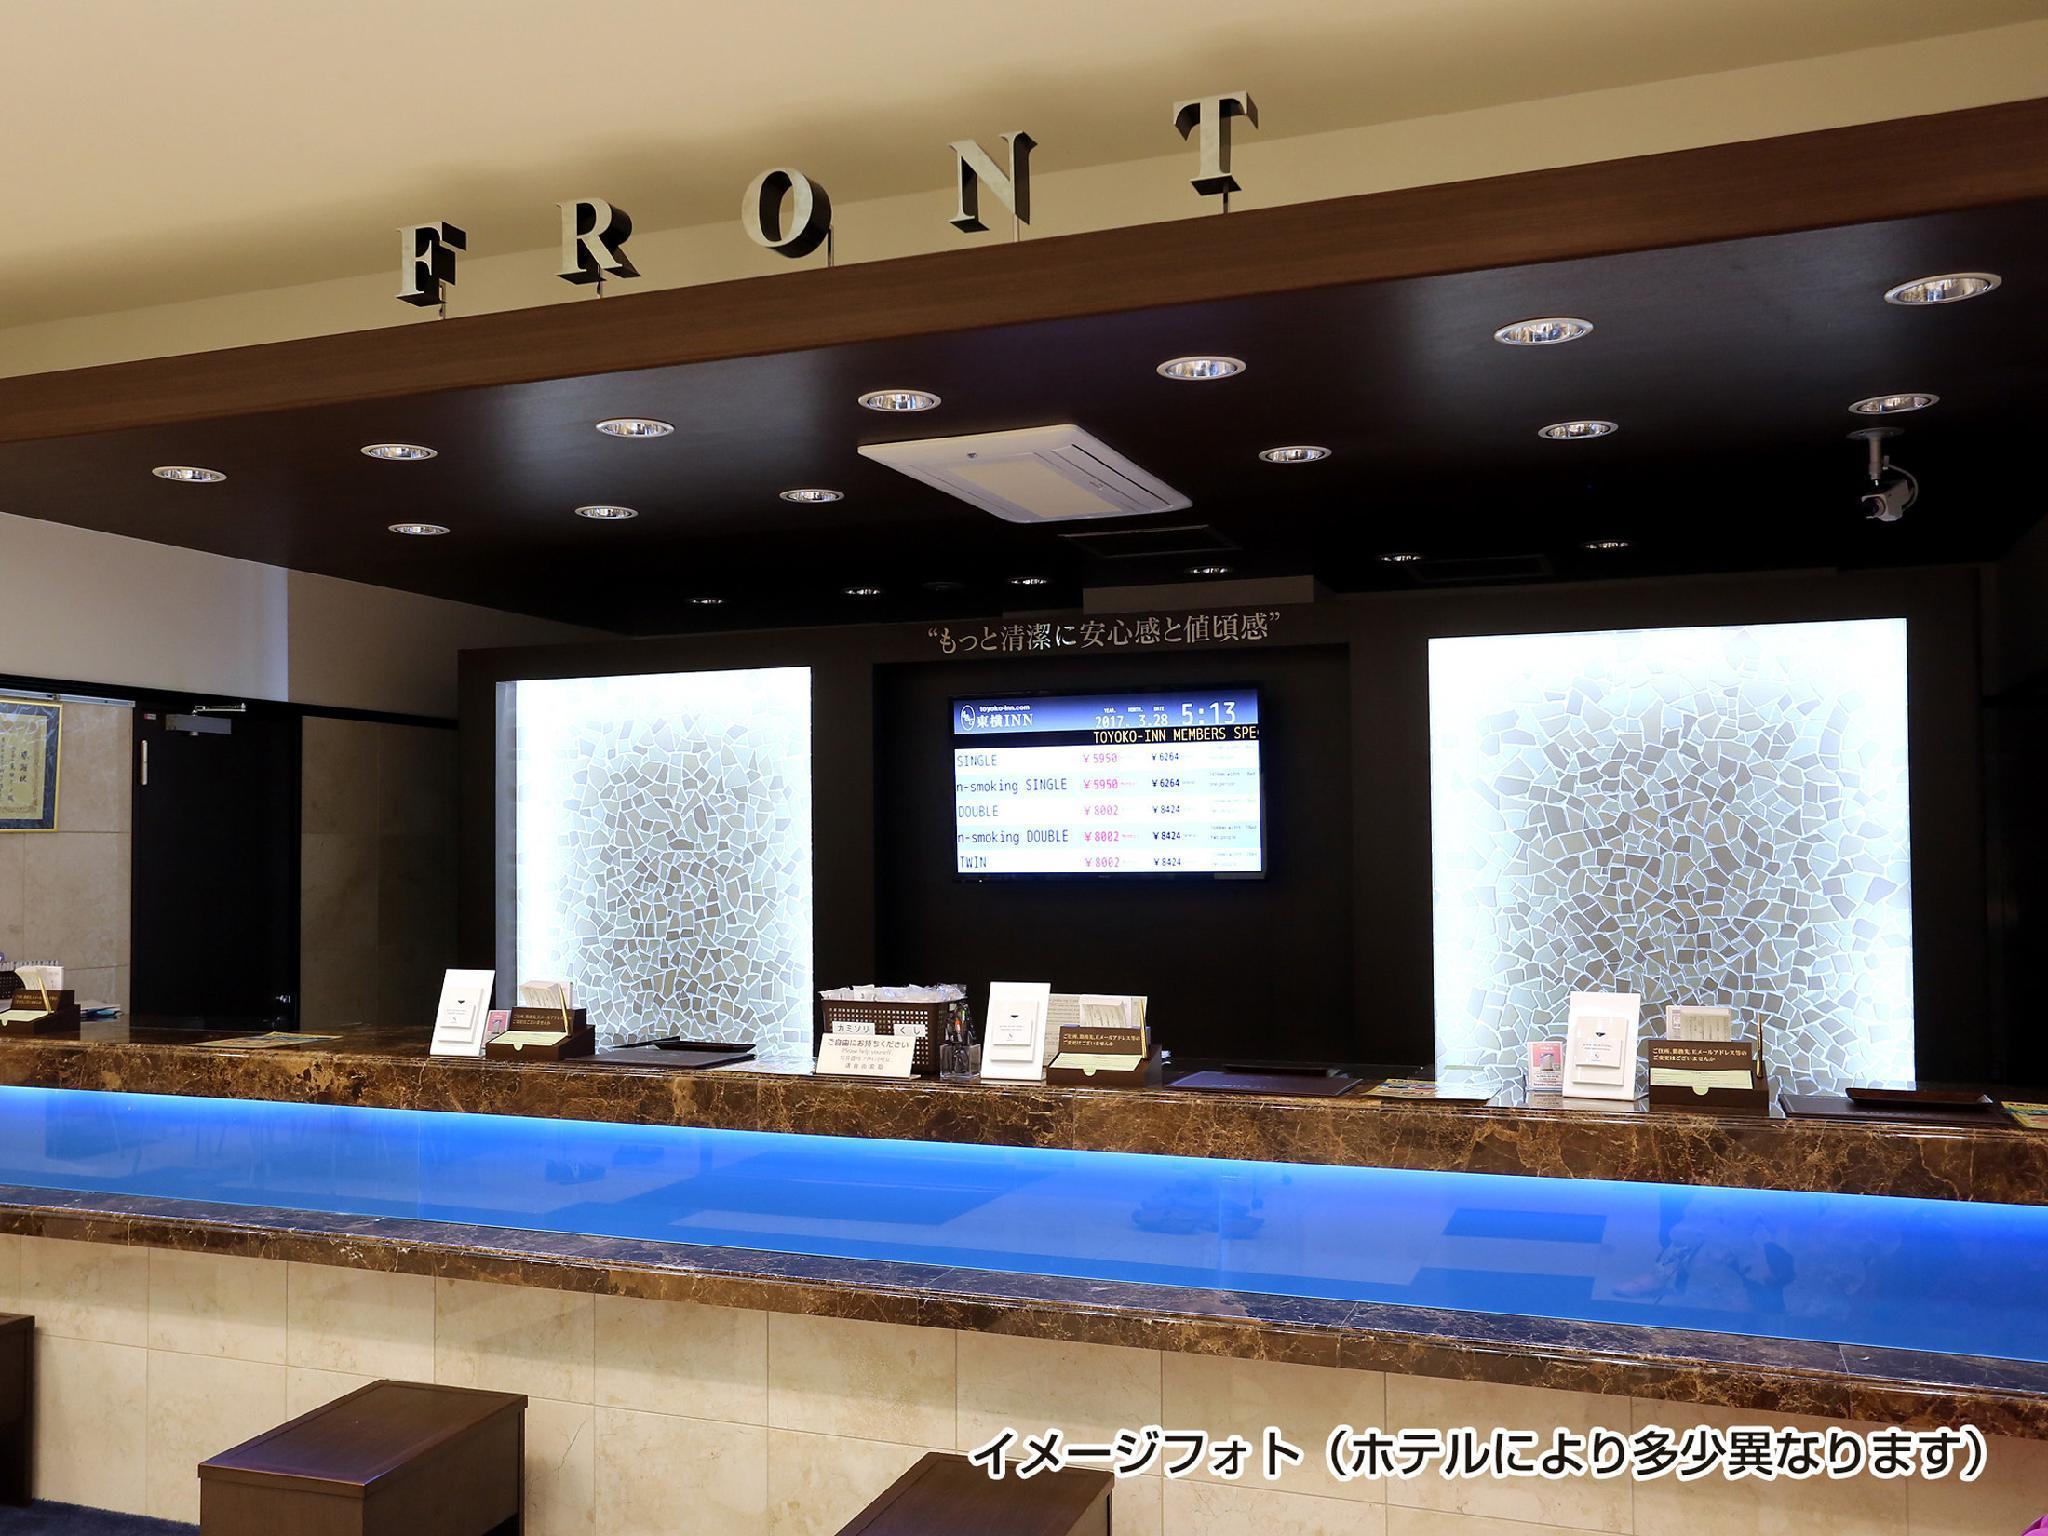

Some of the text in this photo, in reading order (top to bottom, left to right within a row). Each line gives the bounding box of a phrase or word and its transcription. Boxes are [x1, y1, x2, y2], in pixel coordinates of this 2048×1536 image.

[396, 90, 1259, 307] FRONT
[1181, 701, 1236, 726] 5:13
[1093, 725, 1259, 744] TOYOKO-INN MEMBERS SPE
[956, 754, 998, 768] SINGLE
[1026, 778, 1068, 791] SINGLE
[958, 805, 999, 818] DOUBLE
[1026, 828, 1069, 842] DOUBLE
[960, 855, 988, 869] TWIN
[837, 1023, 870, 1033] カミソリ
[827, 1038, 910, 1049] ご自由にお持ちください
